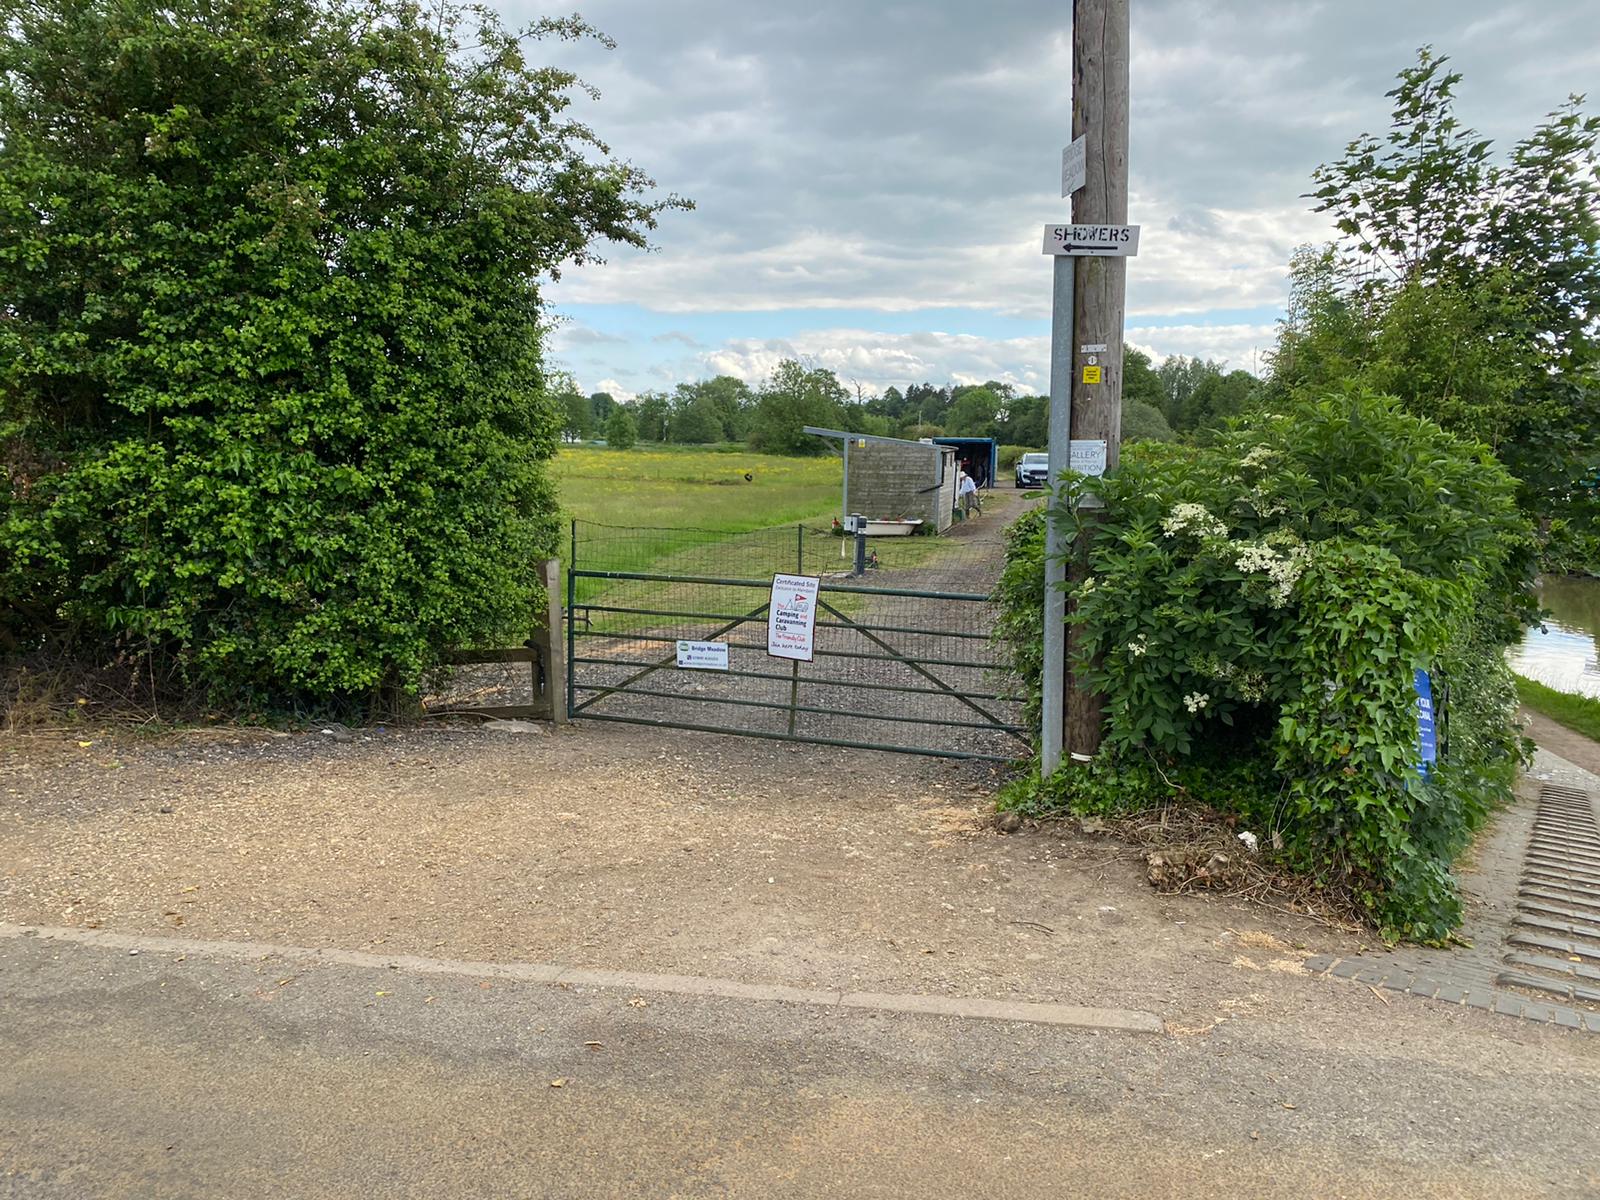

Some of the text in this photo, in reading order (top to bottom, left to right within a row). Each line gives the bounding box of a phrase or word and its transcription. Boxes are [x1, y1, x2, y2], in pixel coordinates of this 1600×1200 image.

[1054, 226, 1130, 242] SHOWERS
[1071, 450, 1100, 459] ALLERY
[776, 578, 805, 587] Certificated
[776, 609, 799, 619] Camping
[775, 616, 807, 628] Caravanning
